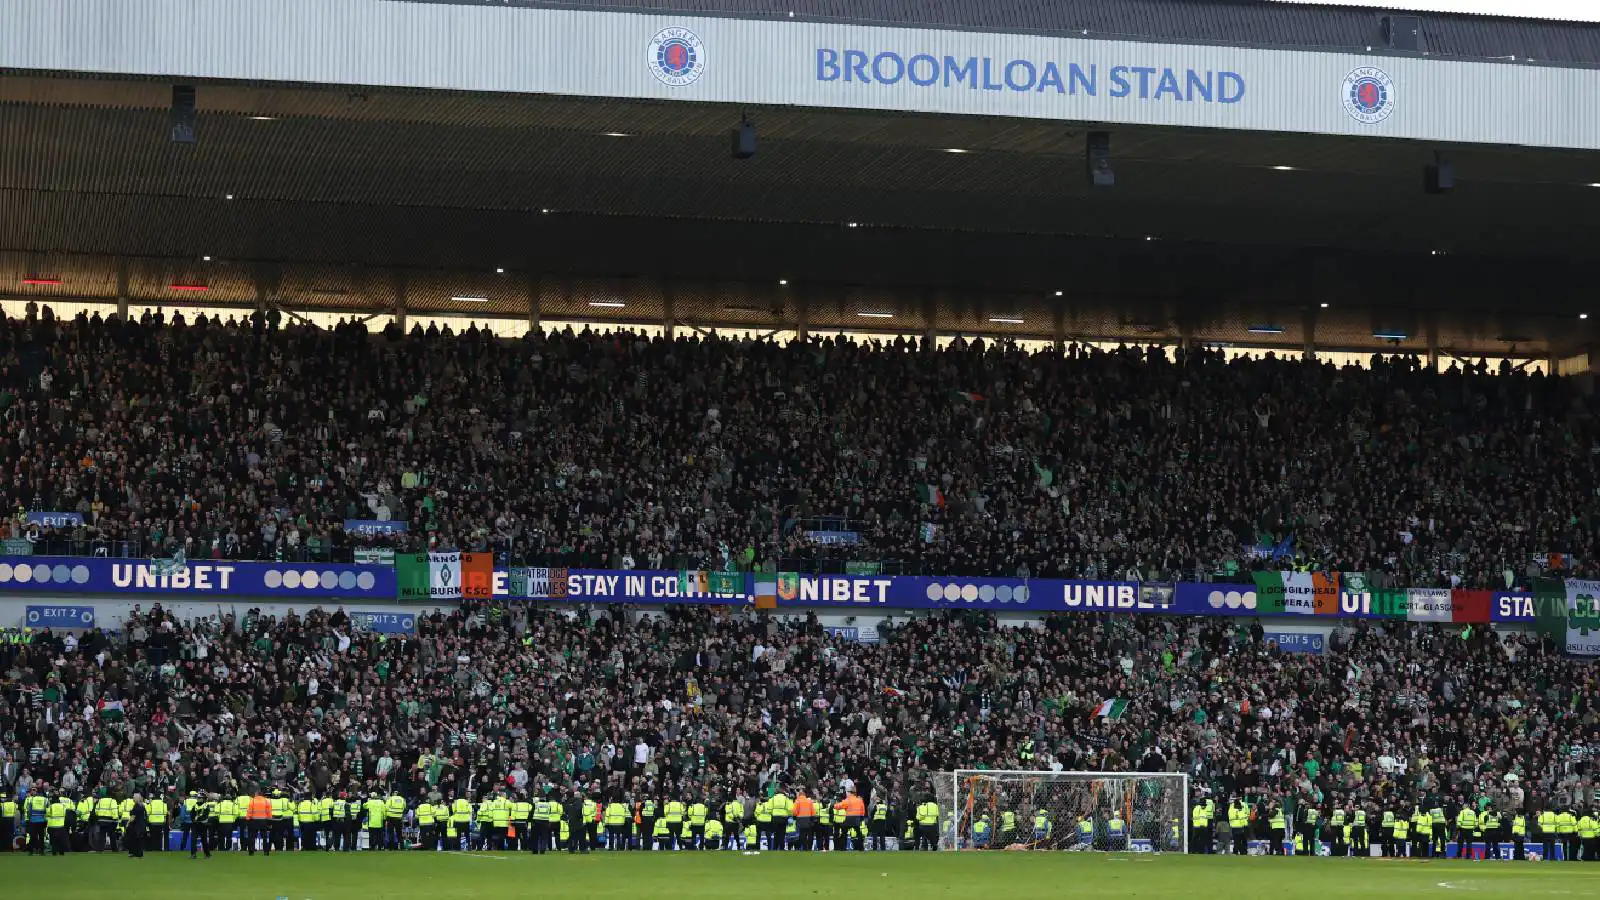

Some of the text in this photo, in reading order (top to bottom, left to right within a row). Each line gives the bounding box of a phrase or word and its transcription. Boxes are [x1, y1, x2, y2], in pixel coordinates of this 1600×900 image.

[654, 29, 700, 47] RANGERS
[816, 48, 1245, 104] BROOMLOAN STAND
[1347, 68, 1390, 86] RANGERS
[43, 515, 68, 527] EXIT
[359, 524, 392, 535] EXIT 3
[416, 554, 473, 563] GARNGAD
[112, 563, 235, 589] UNIBET
[401, 586, 488, 596] MILLBURN CSC
[530, 581, 568, 597] JAMES
[568, 574, 619, 596] STAY
[625, 575, 646, 596] IN
[777, 577, 892, 602] UNIBET
[1260, 586, 1337, 596] LOCHGILPHEAD
[1063, 584, 1173, 609] UNIBET
[1274, 599, 1324, 607] EMERALD
[43, 608, 77, 618] EXIT 2
[367, 614, 397, 624] EXIT 3
[1279, 634, 1309, 645] EXIT 5
